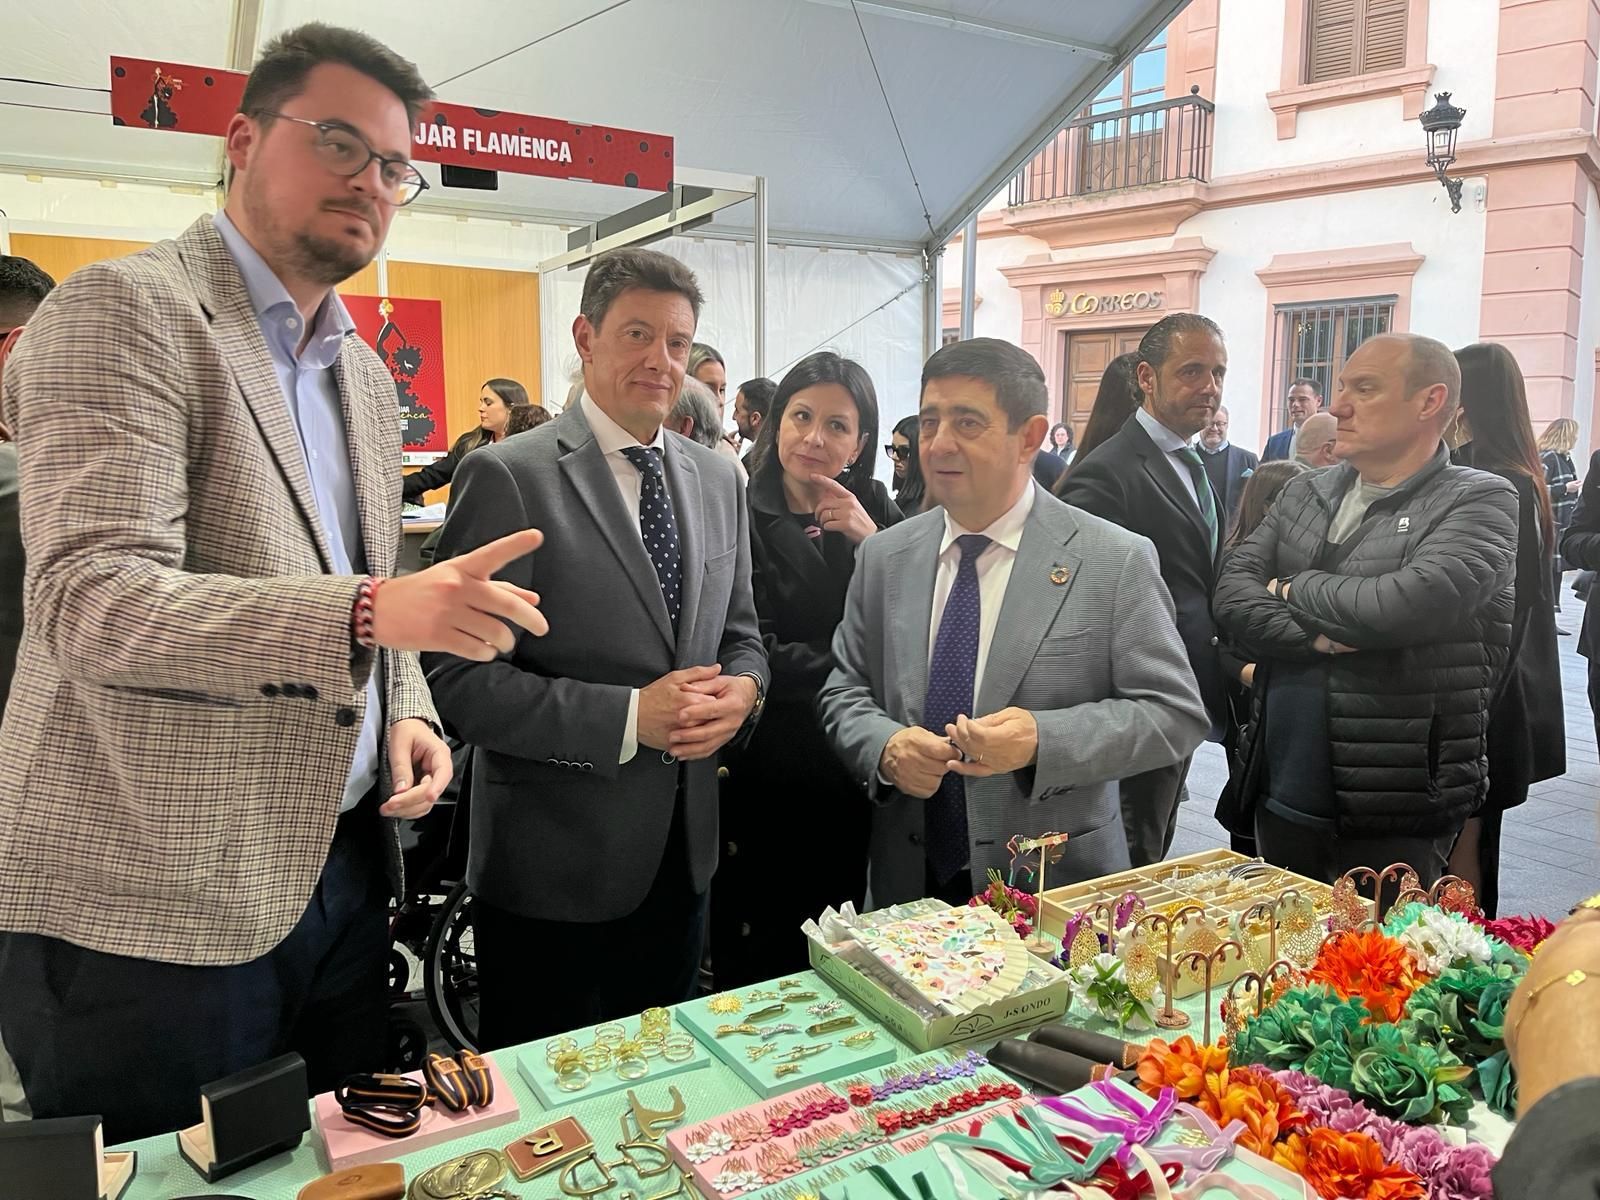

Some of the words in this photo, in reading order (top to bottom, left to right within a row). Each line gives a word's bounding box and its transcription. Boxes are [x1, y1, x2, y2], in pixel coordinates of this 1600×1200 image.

[415, 123, 457, 149] JAR
[462, 128, 573, 163] FLAMENCA
[1070, 291, 1162, 314] CORREOS
